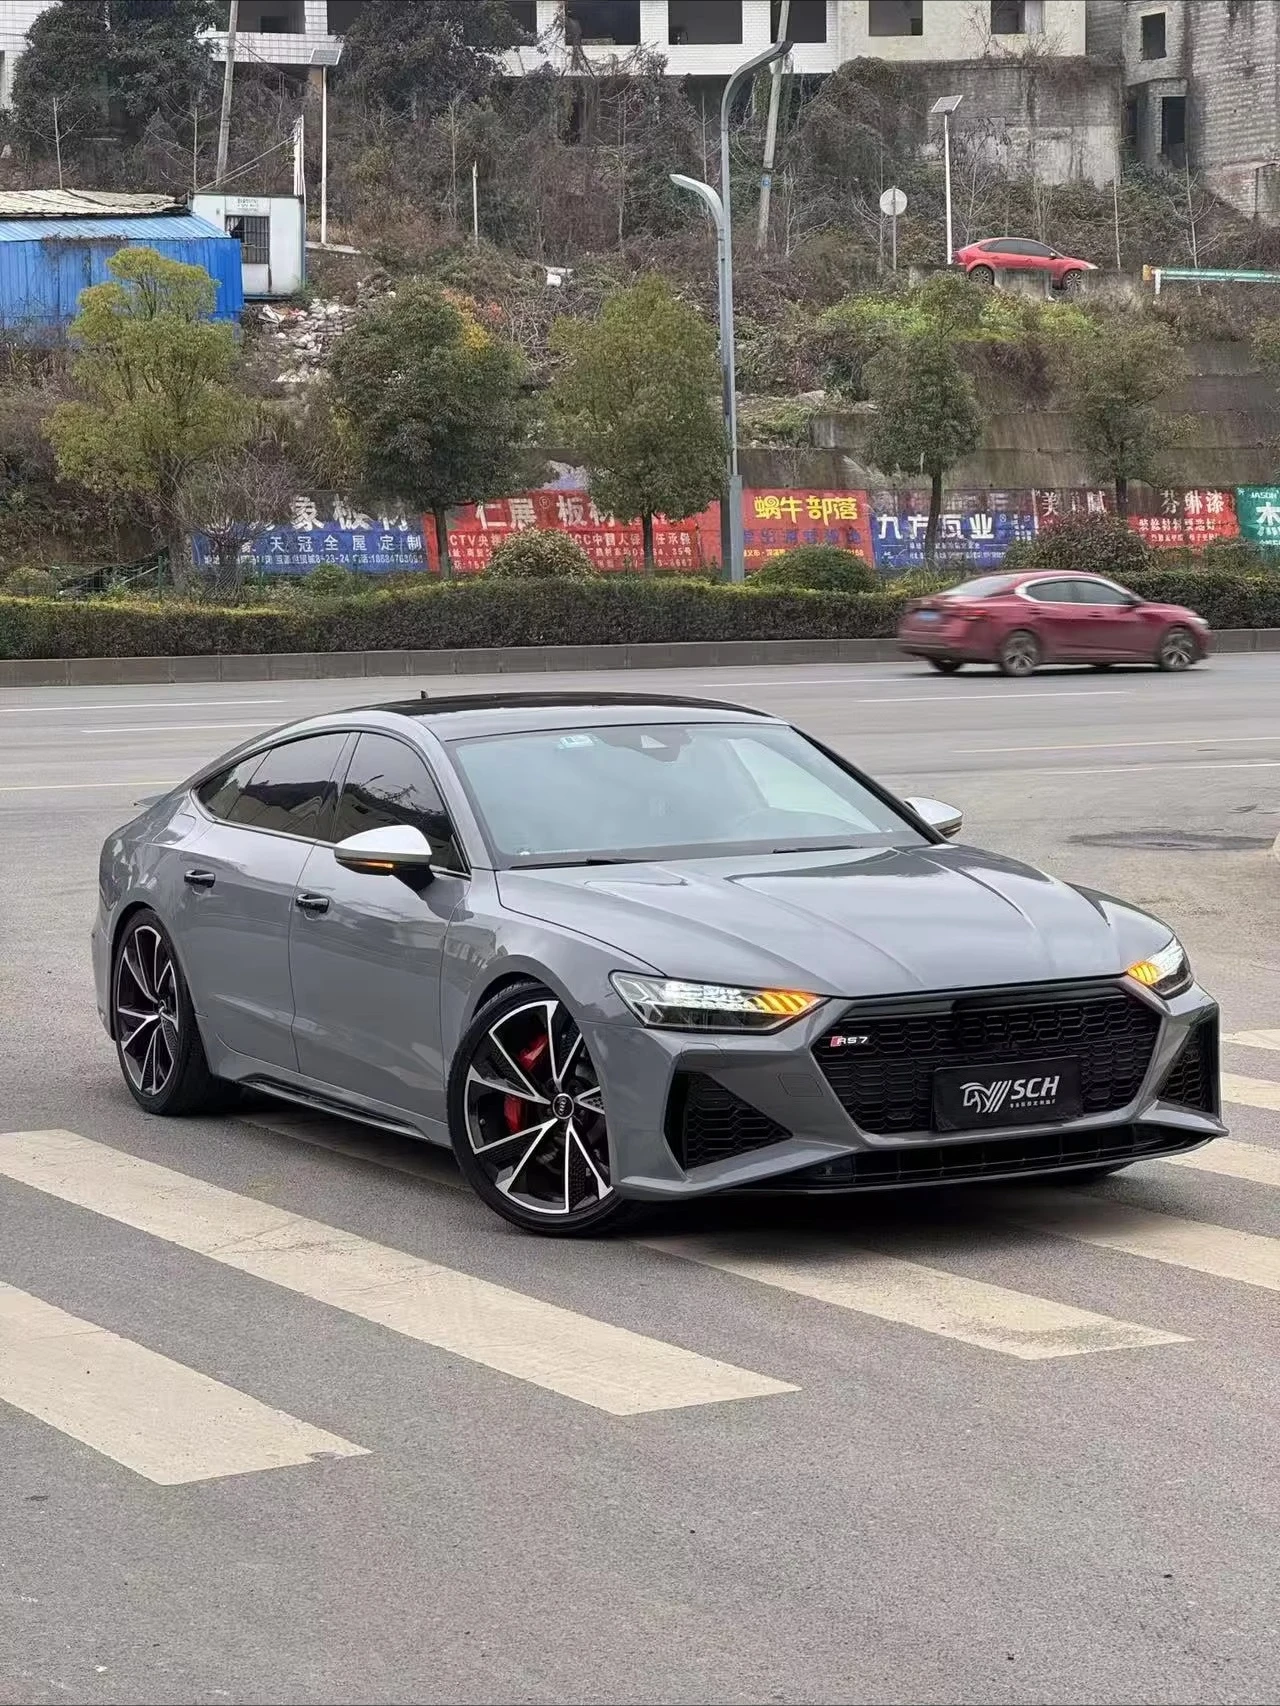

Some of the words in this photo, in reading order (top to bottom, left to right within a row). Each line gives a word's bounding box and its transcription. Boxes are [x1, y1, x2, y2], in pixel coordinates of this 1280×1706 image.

[754, 496, 858, 527] 蜗牛部落
[876, 513, 995, 540] 九方瓦业
[830, 1035, 869, 1048] RS7
[1011, 1075, 1060, 1100] SCH
